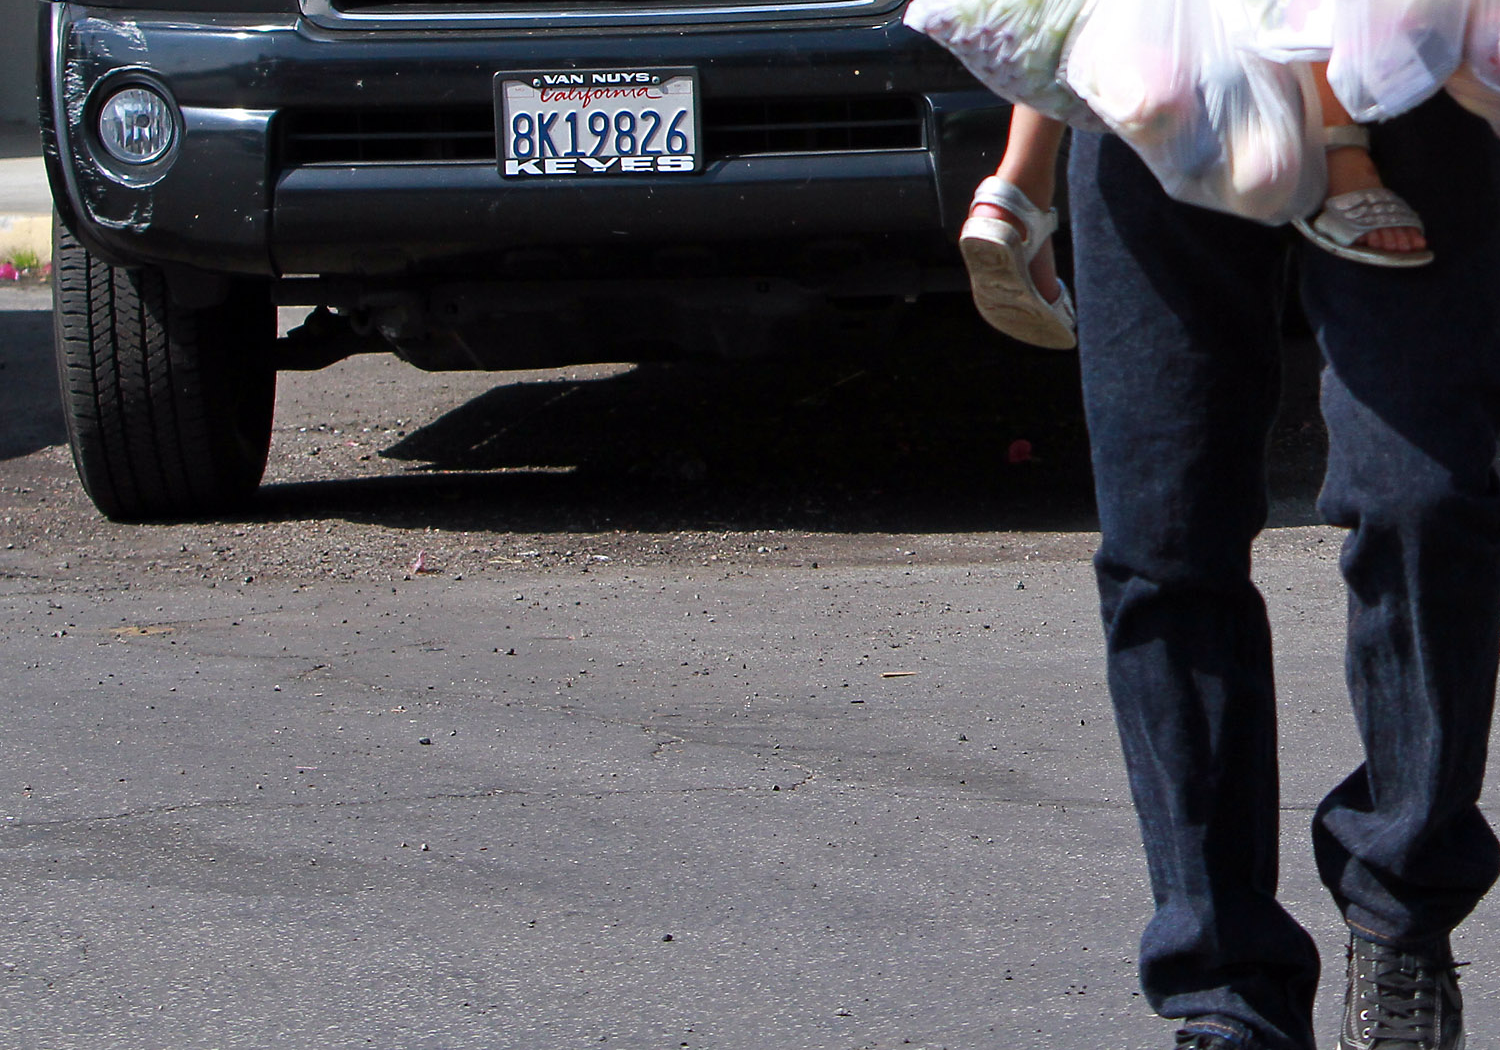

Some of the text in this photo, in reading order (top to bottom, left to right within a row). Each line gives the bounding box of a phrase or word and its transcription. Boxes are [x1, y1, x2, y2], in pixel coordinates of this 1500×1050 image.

[543, 72, 650, 85] VAN NUYS
[541, 86, 663, 108] California
[511, 109, 689, 157] 8K19826
[504, 155, 695, 176] KEYES
